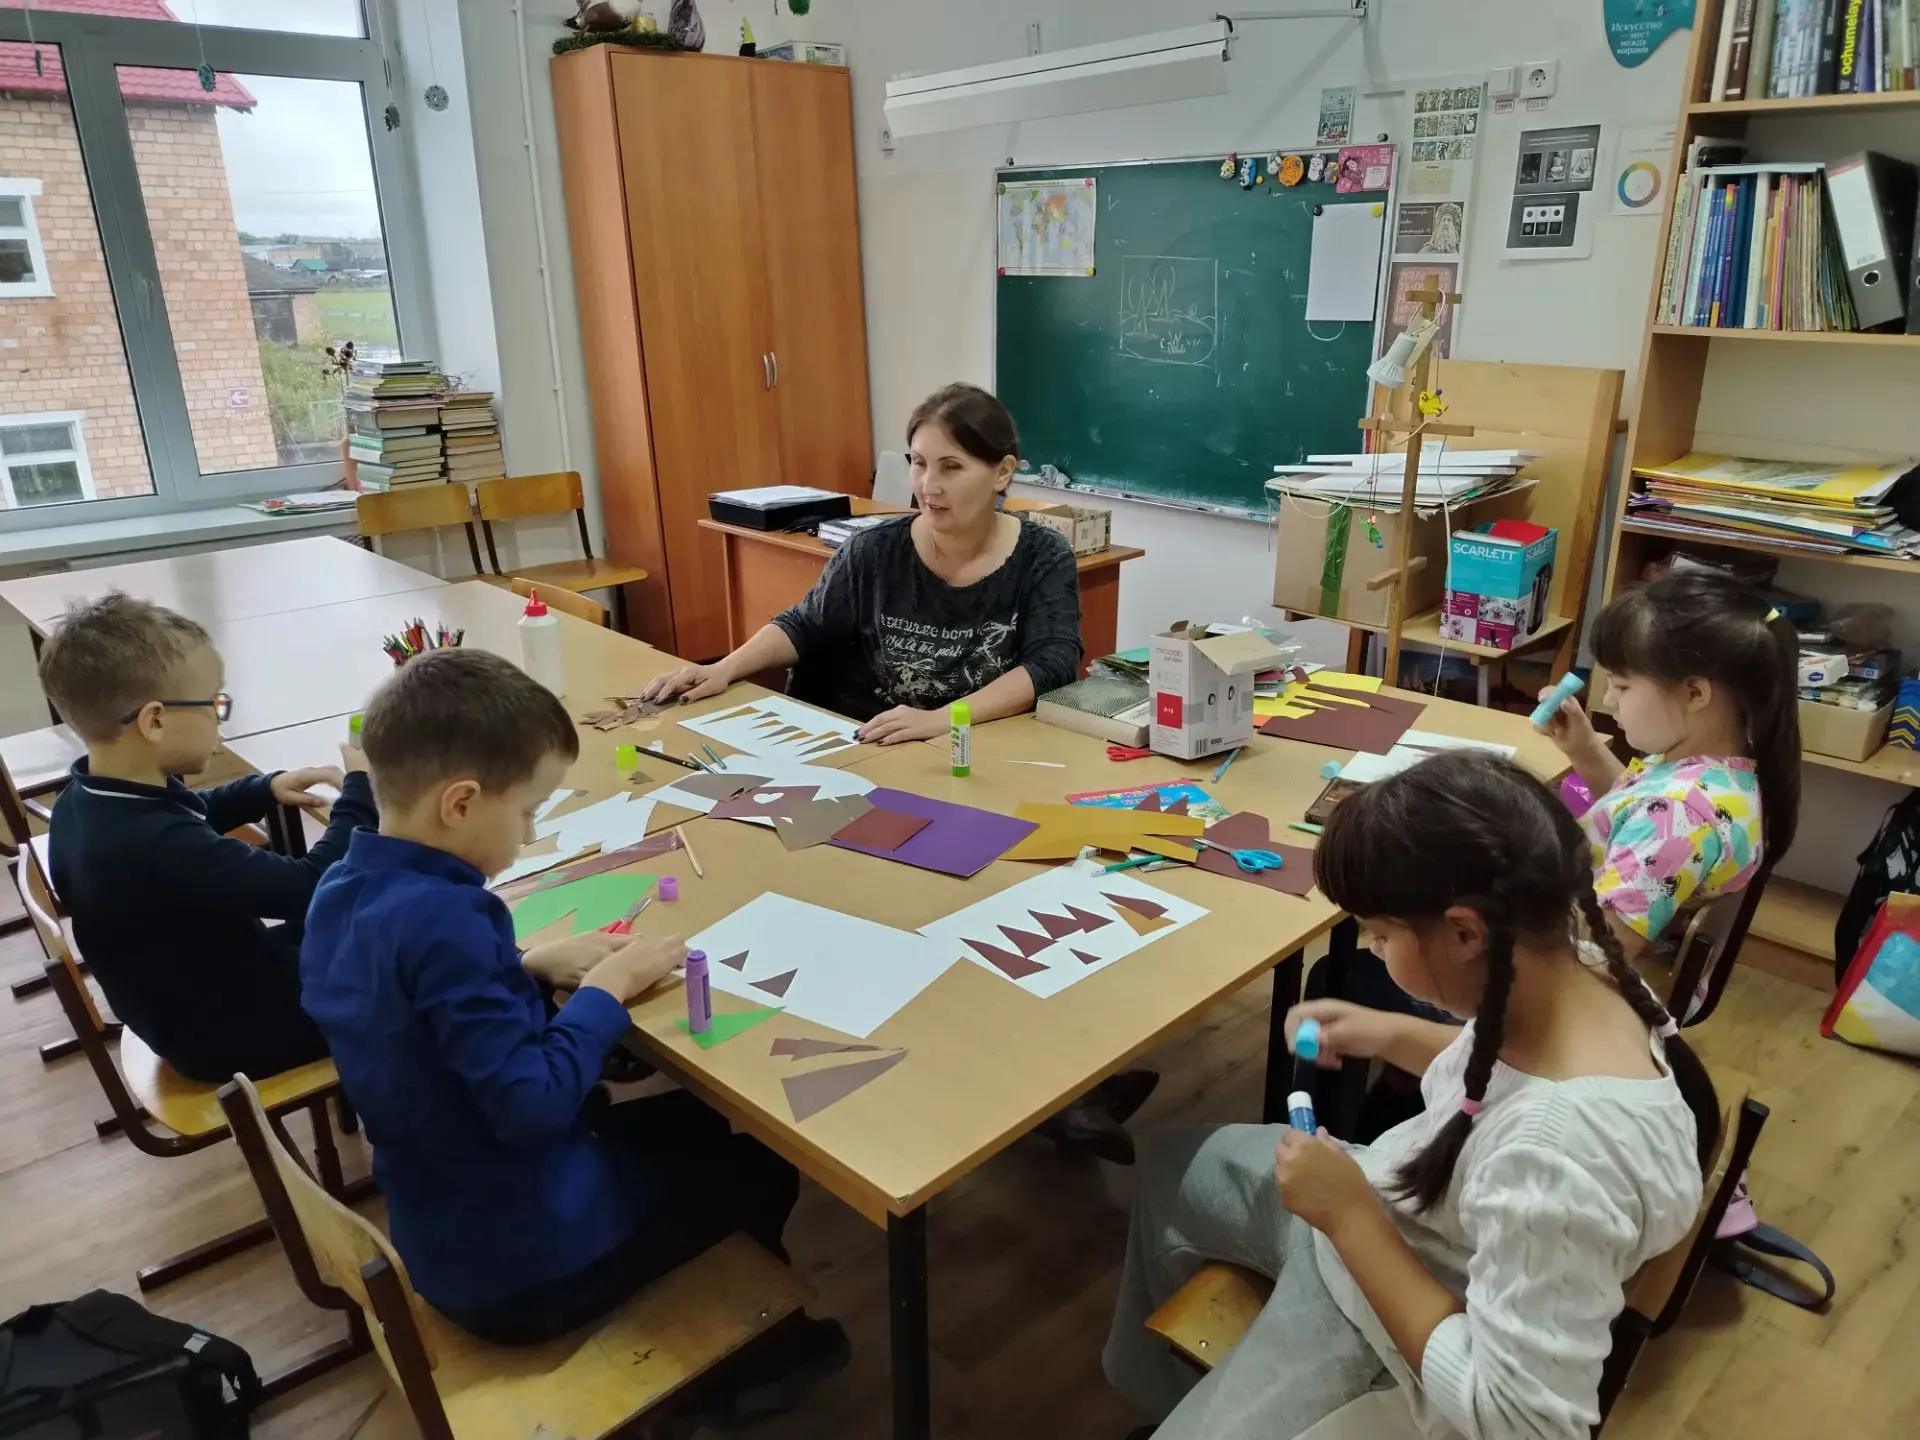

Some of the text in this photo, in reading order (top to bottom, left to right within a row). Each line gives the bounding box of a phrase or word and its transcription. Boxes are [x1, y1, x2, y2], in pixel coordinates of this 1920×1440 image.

[1611, 21, 1663, 32] Искусство
[1616, 47, 1649, 56] мирами
[1453, 542, 1517, 561] SCARLETT
[1524, 539, 1553, 562] SCARLETT
